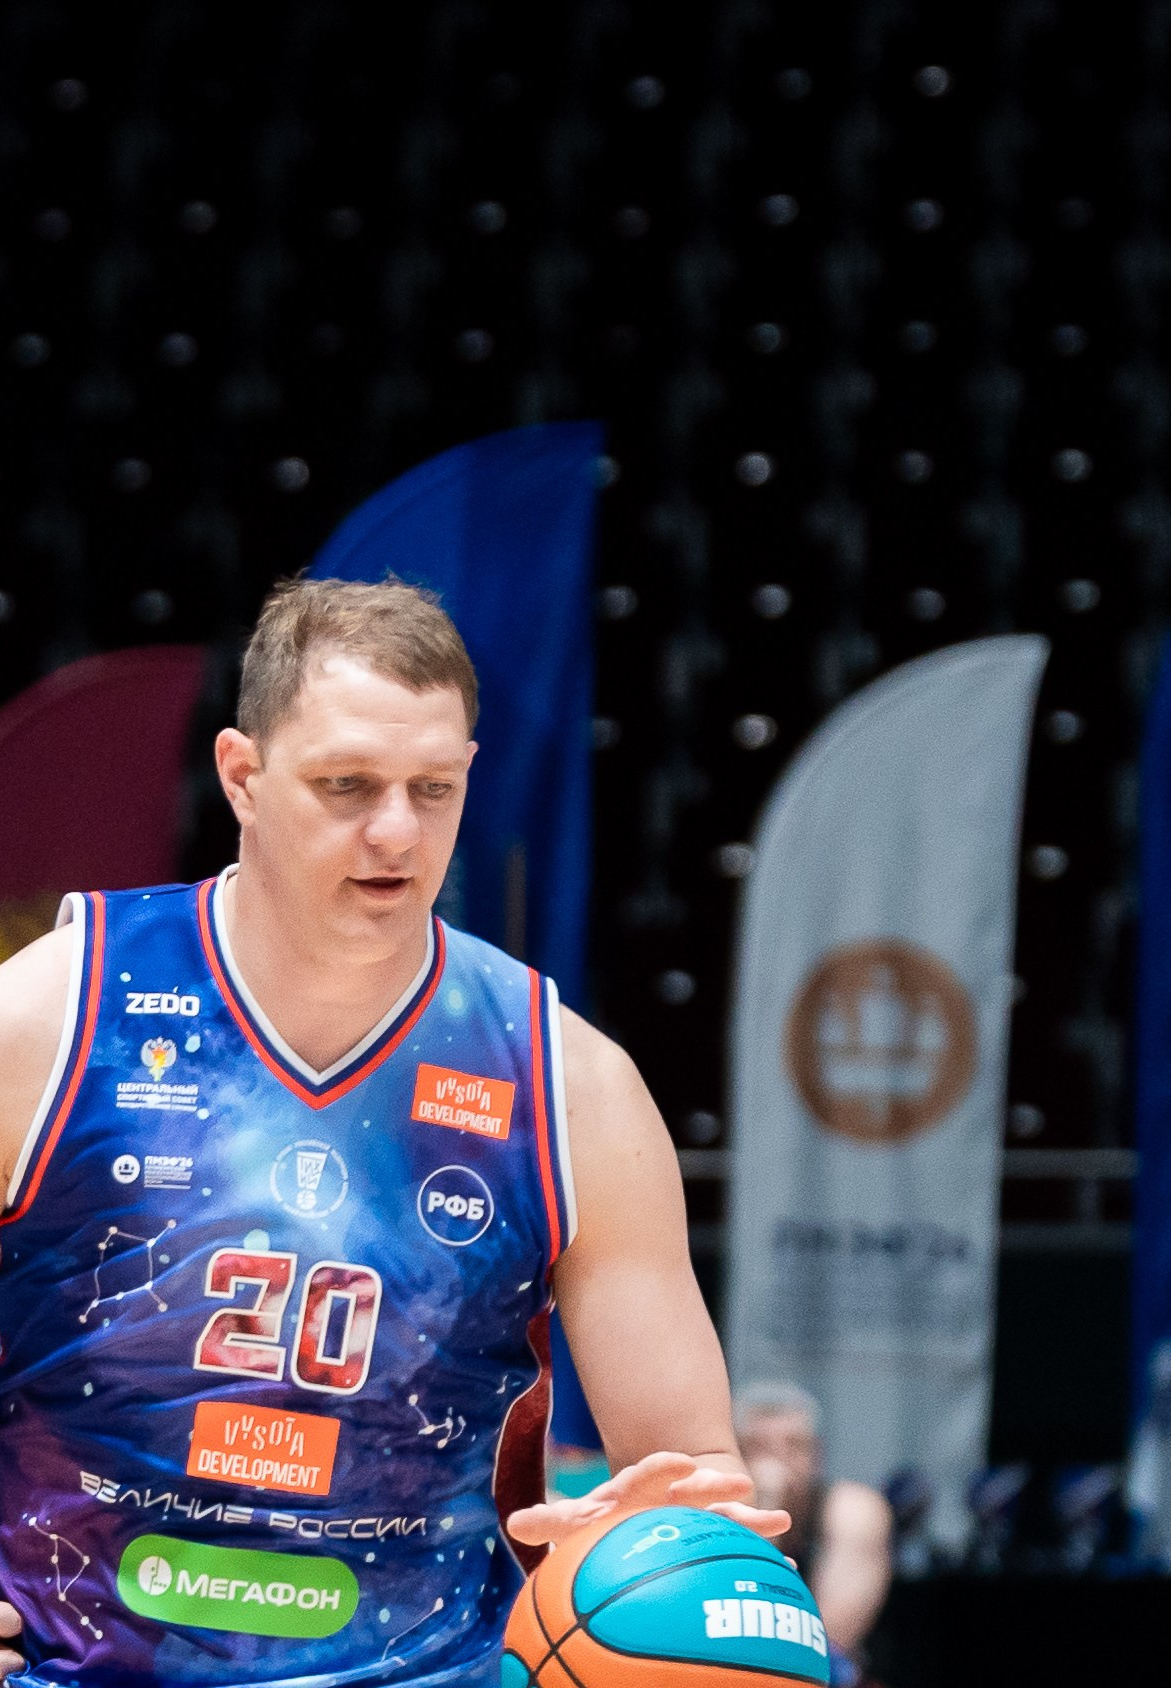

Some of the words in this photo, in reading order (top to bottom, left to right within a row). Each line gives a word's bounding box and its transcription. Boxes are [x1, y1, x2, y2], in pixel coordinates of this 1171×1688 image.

[125, 991, 201, 1018] ZEDO
[435, 1077, 491, 1112] VYSOTA
[418, 1100, 503, 1134] DEVELOPMENT
[427, 1190, 485, 1221] РФБ
[192, 1247, 383, 1396] 20
[224, 1414, 305, 1458] VYSOTA
[197, 1448, 322, 1489] DEVELOPMENT
[79, 1470, 255, 1525] ВЕЛИЧИЕ
[269, 1512, 427, 1539] РОССИИ
[175, 1569, 341, 1610] МЕГАФОН
[702, 1598, 828, 1658] SIBUR
